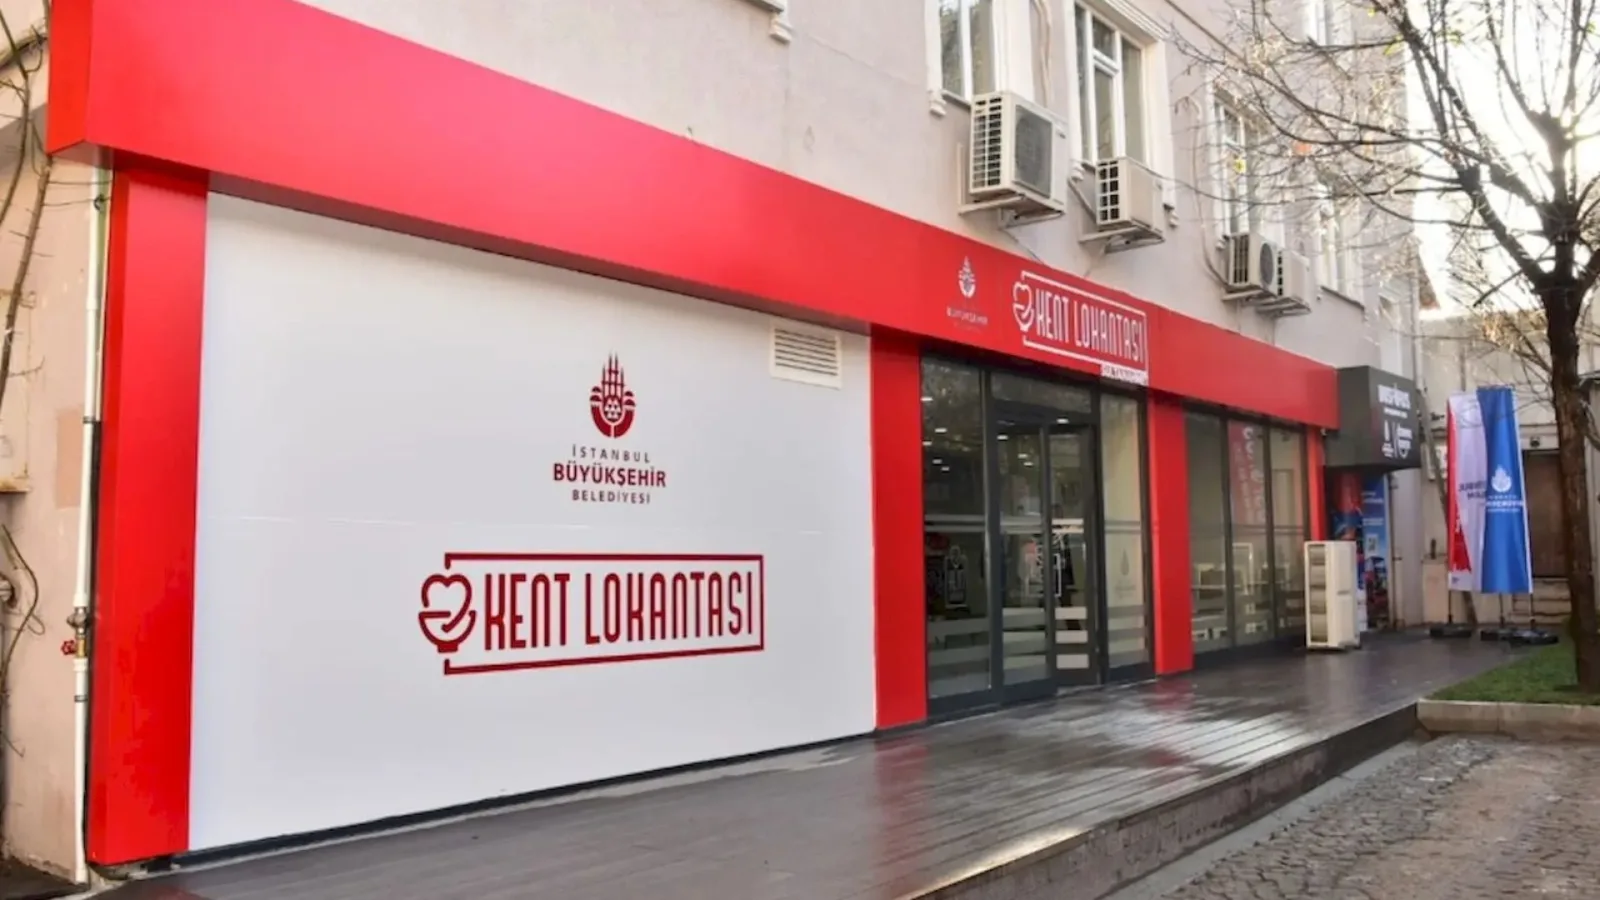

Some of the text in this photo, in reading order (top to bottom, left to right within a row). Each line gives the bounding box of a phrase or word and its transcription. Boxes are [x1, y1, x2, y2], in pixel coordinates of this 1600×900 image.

[1035, 288, 1144, 363] KENT LOKANTASI
[553, 460, 667, 487] BÜYÜKŞEHİR
[572, 444, 650, 463] İSTANBUL
[484, 571, 752, 651] KENT LOKANTASI
